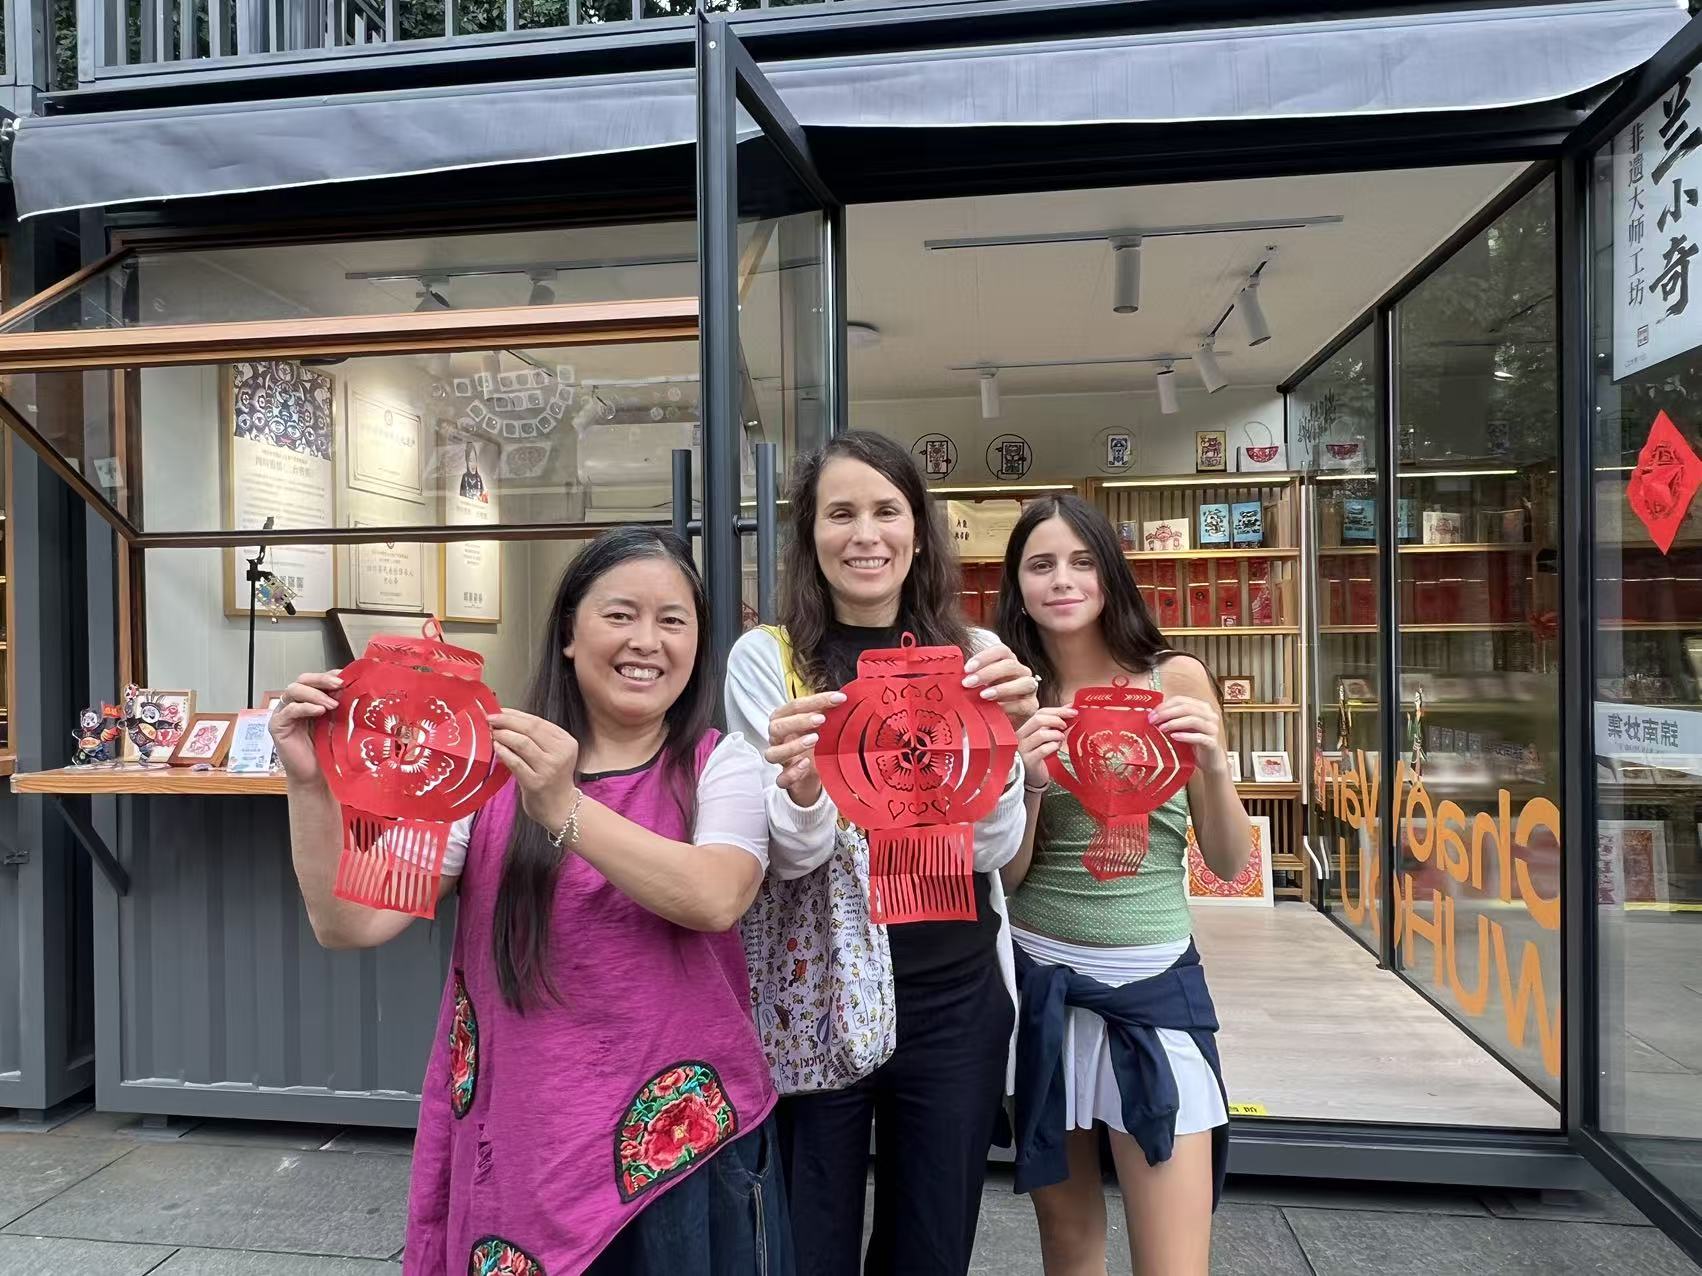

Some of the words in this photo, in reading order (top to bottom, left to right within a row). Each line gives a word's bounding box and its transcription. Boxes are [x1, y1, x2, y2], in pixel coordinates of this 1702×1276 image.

[1627, 122, 1645, 307] 非遗大师工坊
[1649, 75, 1702, 325] 兰小奇
